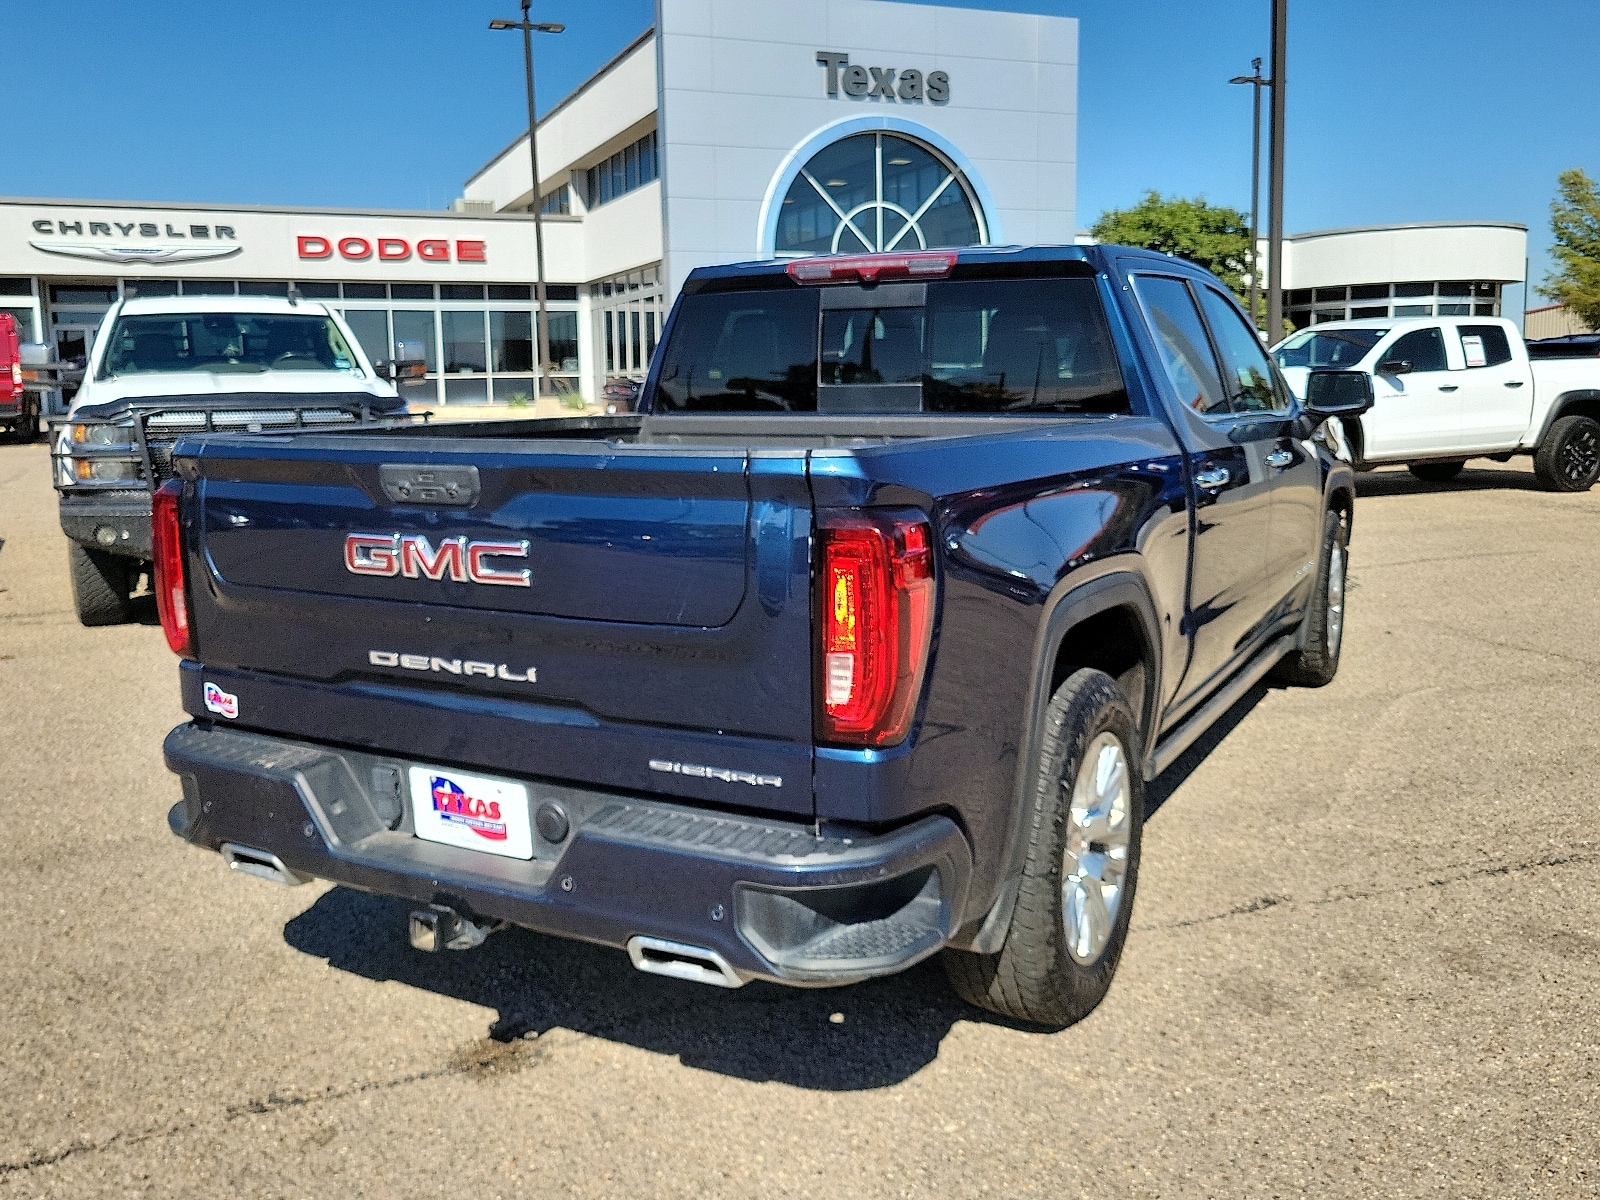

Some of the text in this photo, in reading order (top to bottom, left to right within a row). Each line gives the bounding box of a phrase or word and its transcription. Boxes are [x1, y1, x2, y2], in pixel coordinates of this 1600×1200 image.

[816, 51, 950, 105] Texas
[32, 220, 236, 239] CHRYSLER
[297, 236, 487, 262] DODGE
[345, 532, 531, 587] GMC
[368, 650, 537, 683] DENALI
[433, 788, 502, 821] TEXAS
